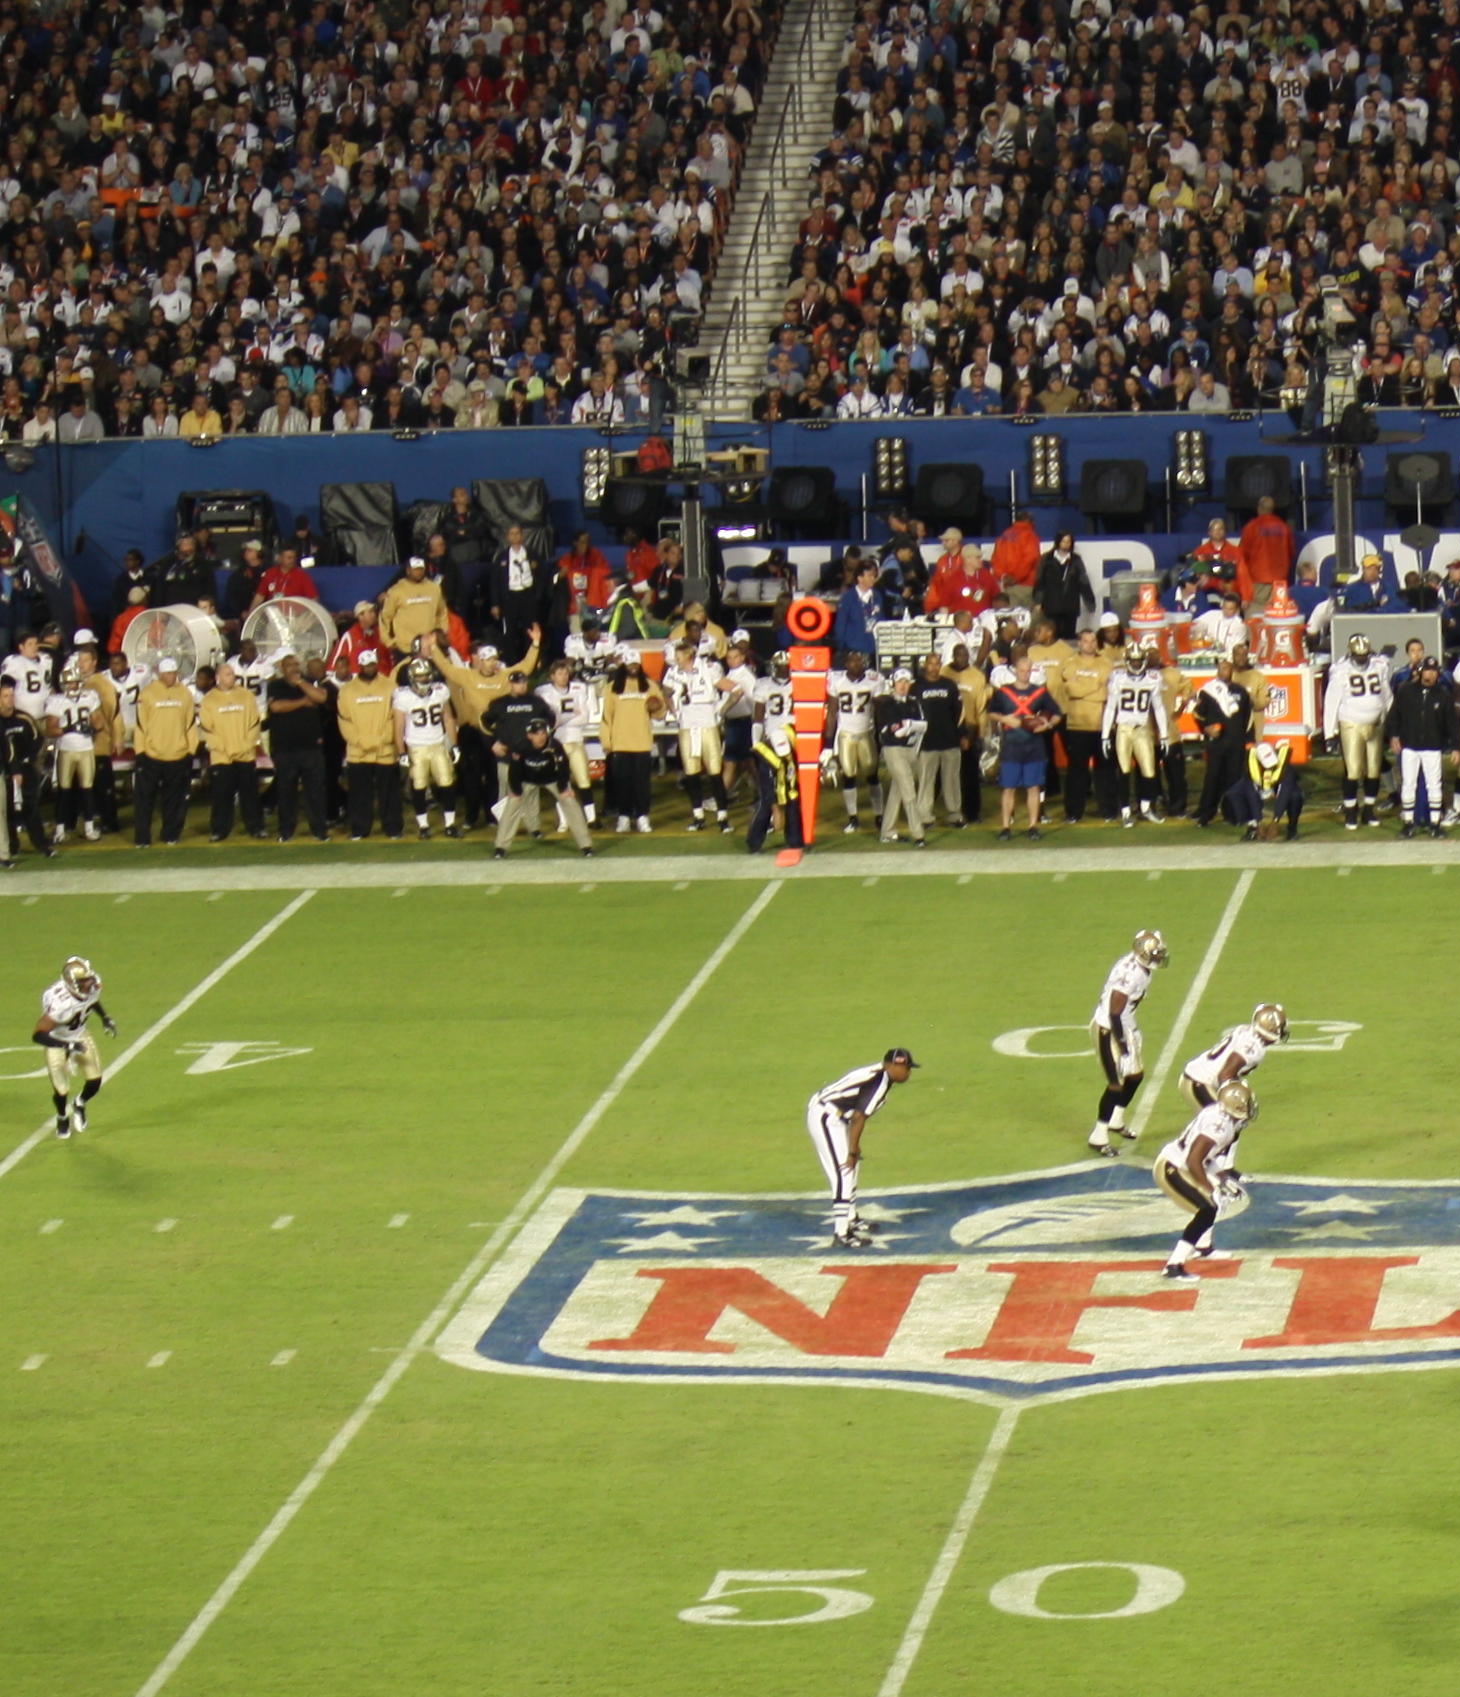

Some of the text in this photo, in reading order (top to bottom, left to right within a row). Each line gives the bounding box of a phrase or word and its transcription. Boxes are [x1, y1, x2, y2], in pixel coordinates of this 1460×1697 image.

[1280, 79, 1302, 98] 88
[1274, 629, 1292, 647] G
[922, 689, 949, 699] SAINTS
[1349, 673, 1382, 696] 92
[838, 692, 871, 713] 27
[1120, 688, 1151, 713] 20
[411, 703, 443, 727] 36
